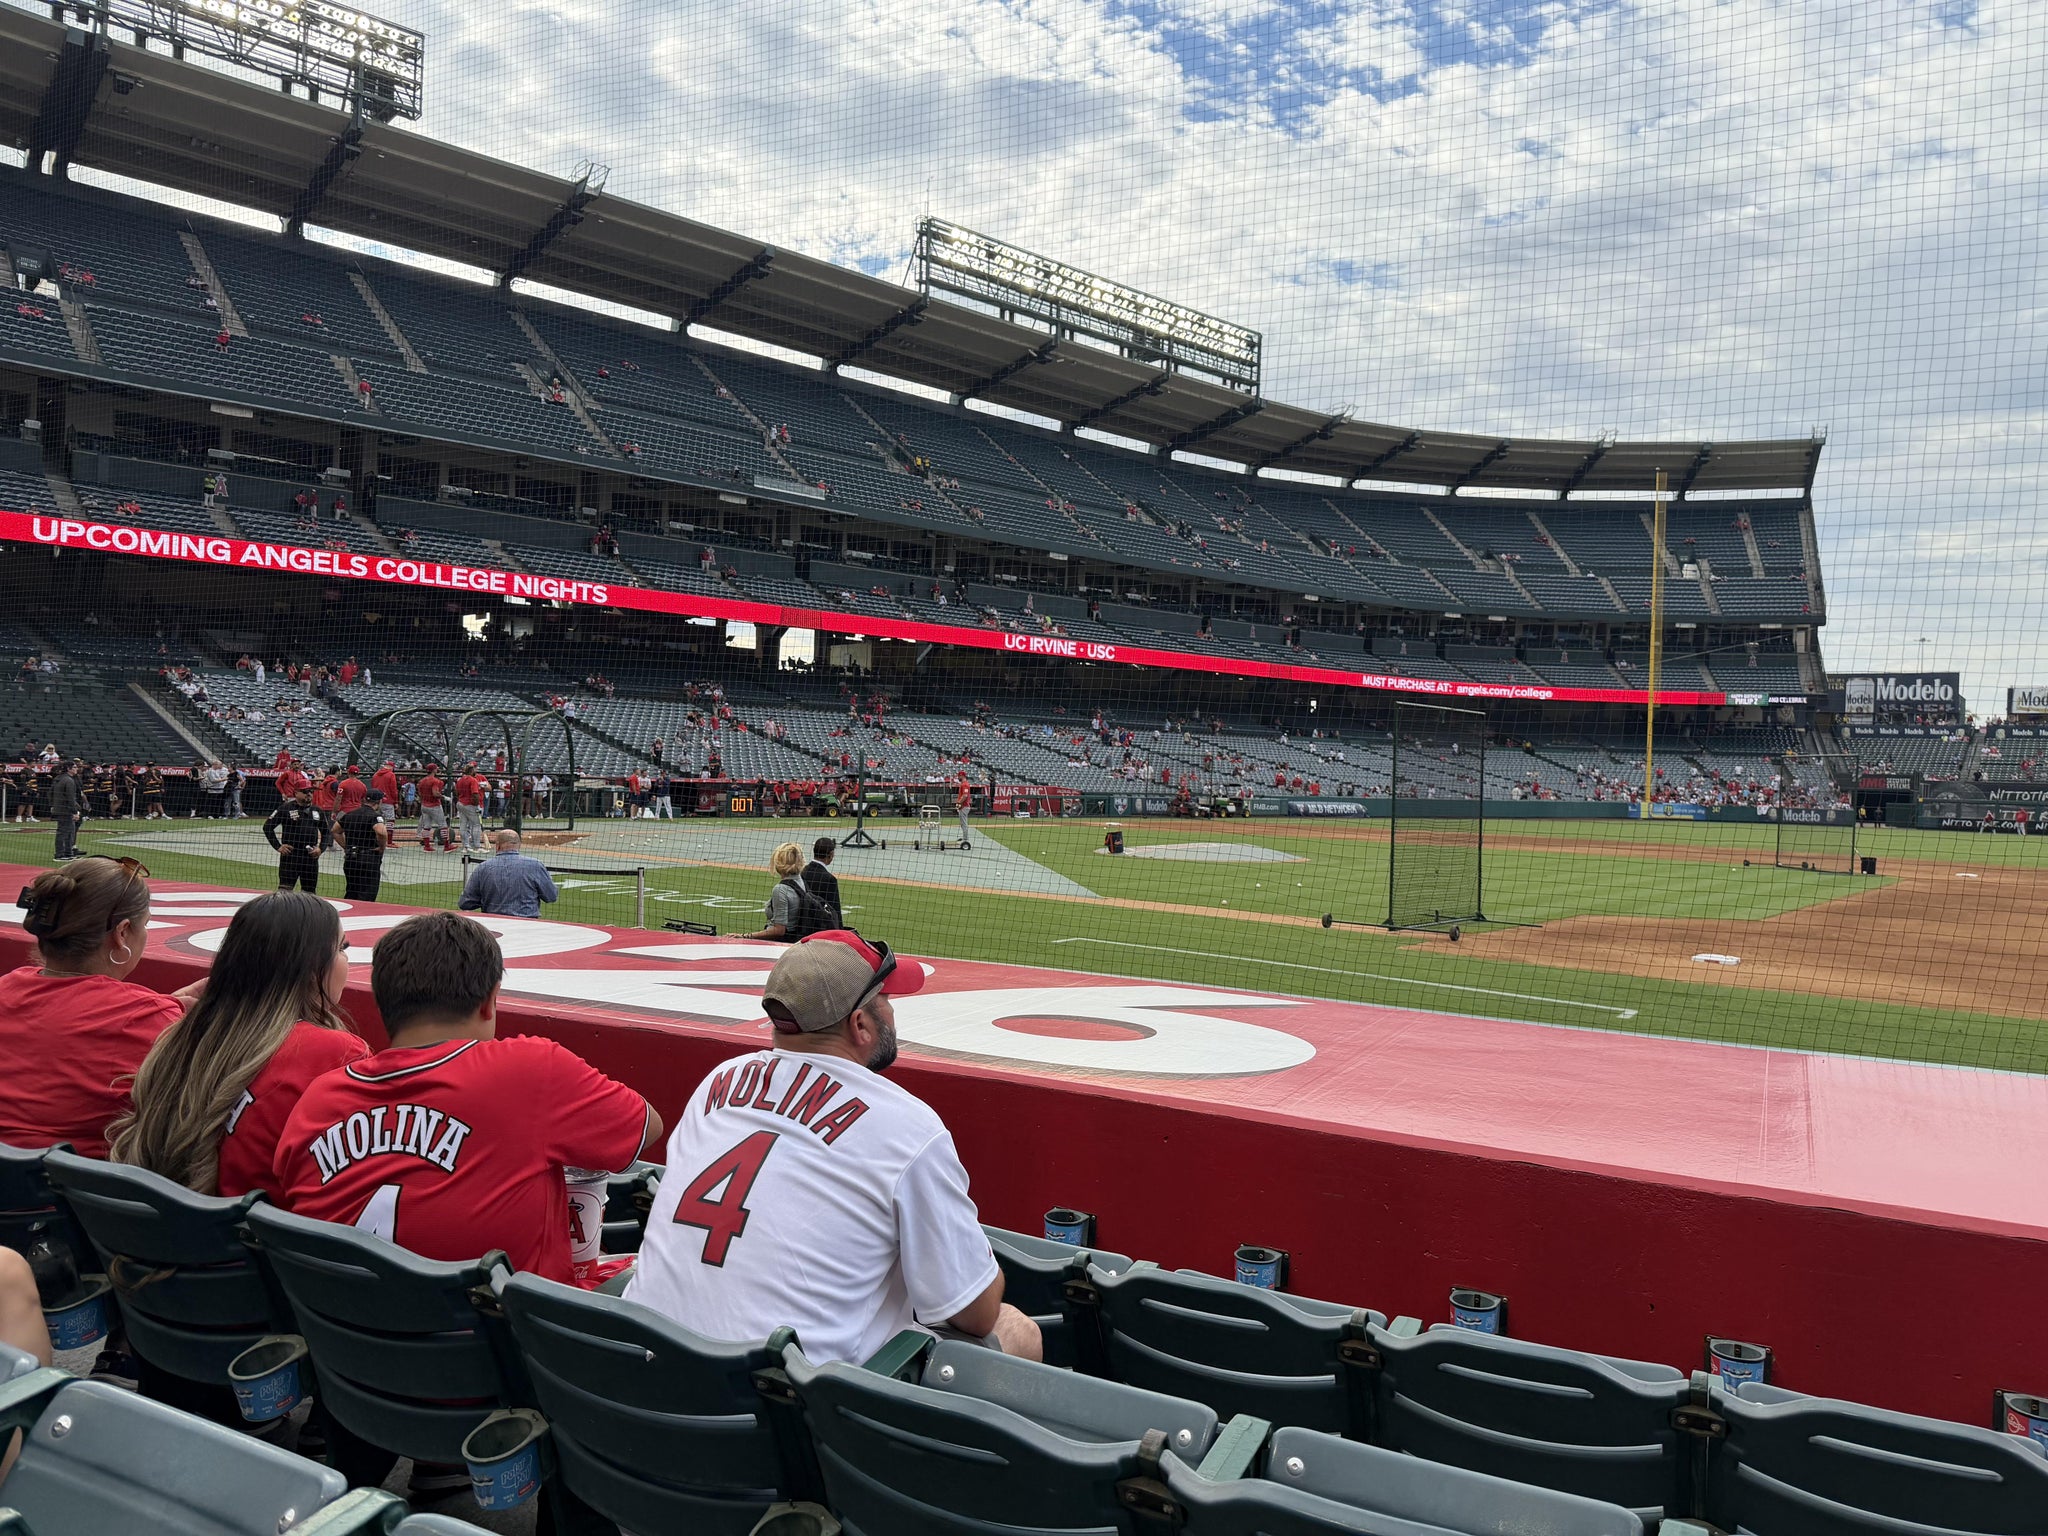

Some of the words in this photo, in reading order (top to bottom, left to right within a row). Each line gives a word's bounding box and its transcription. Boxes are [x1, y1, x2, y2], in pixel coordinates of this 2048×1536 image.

[32, 517, 231, 562] UPCOMING
[239, 544, 368, 577] ANGELS
[376, 559, 506, 593] COLLEGE
[513, 576, 608, 604] NIGHTS
[1004, 634, 1027, 650] UC
[1029, 637, 1077, 656] IRVINE
[1087, 643, 1116, 660] USC
[1362, 675, 1387, 687] MUST
[1387, 677, 1436, 692] PURCHASE
[1456, 685, 1554, 700] angels.com/college
[1876, 677, 1954, 701] Modelo
[731, 797, 753, 812] 007
[1145, 799, 1168, 812] Modelo
[1253, 803, 1279, 811] FMB.com
[1307, 804, 1324, 814] MLB
[1324, 804, 1359, 815] NETWORK
[1782, 808, 1821, 822] Modelo
[1942, 818, 1973, 828] NITTO
[703, 1057, 870, 1147] MOLINA
[309, 1103, 471, 1185] MOLINA
[672, 1130, 781, 1268] 4
